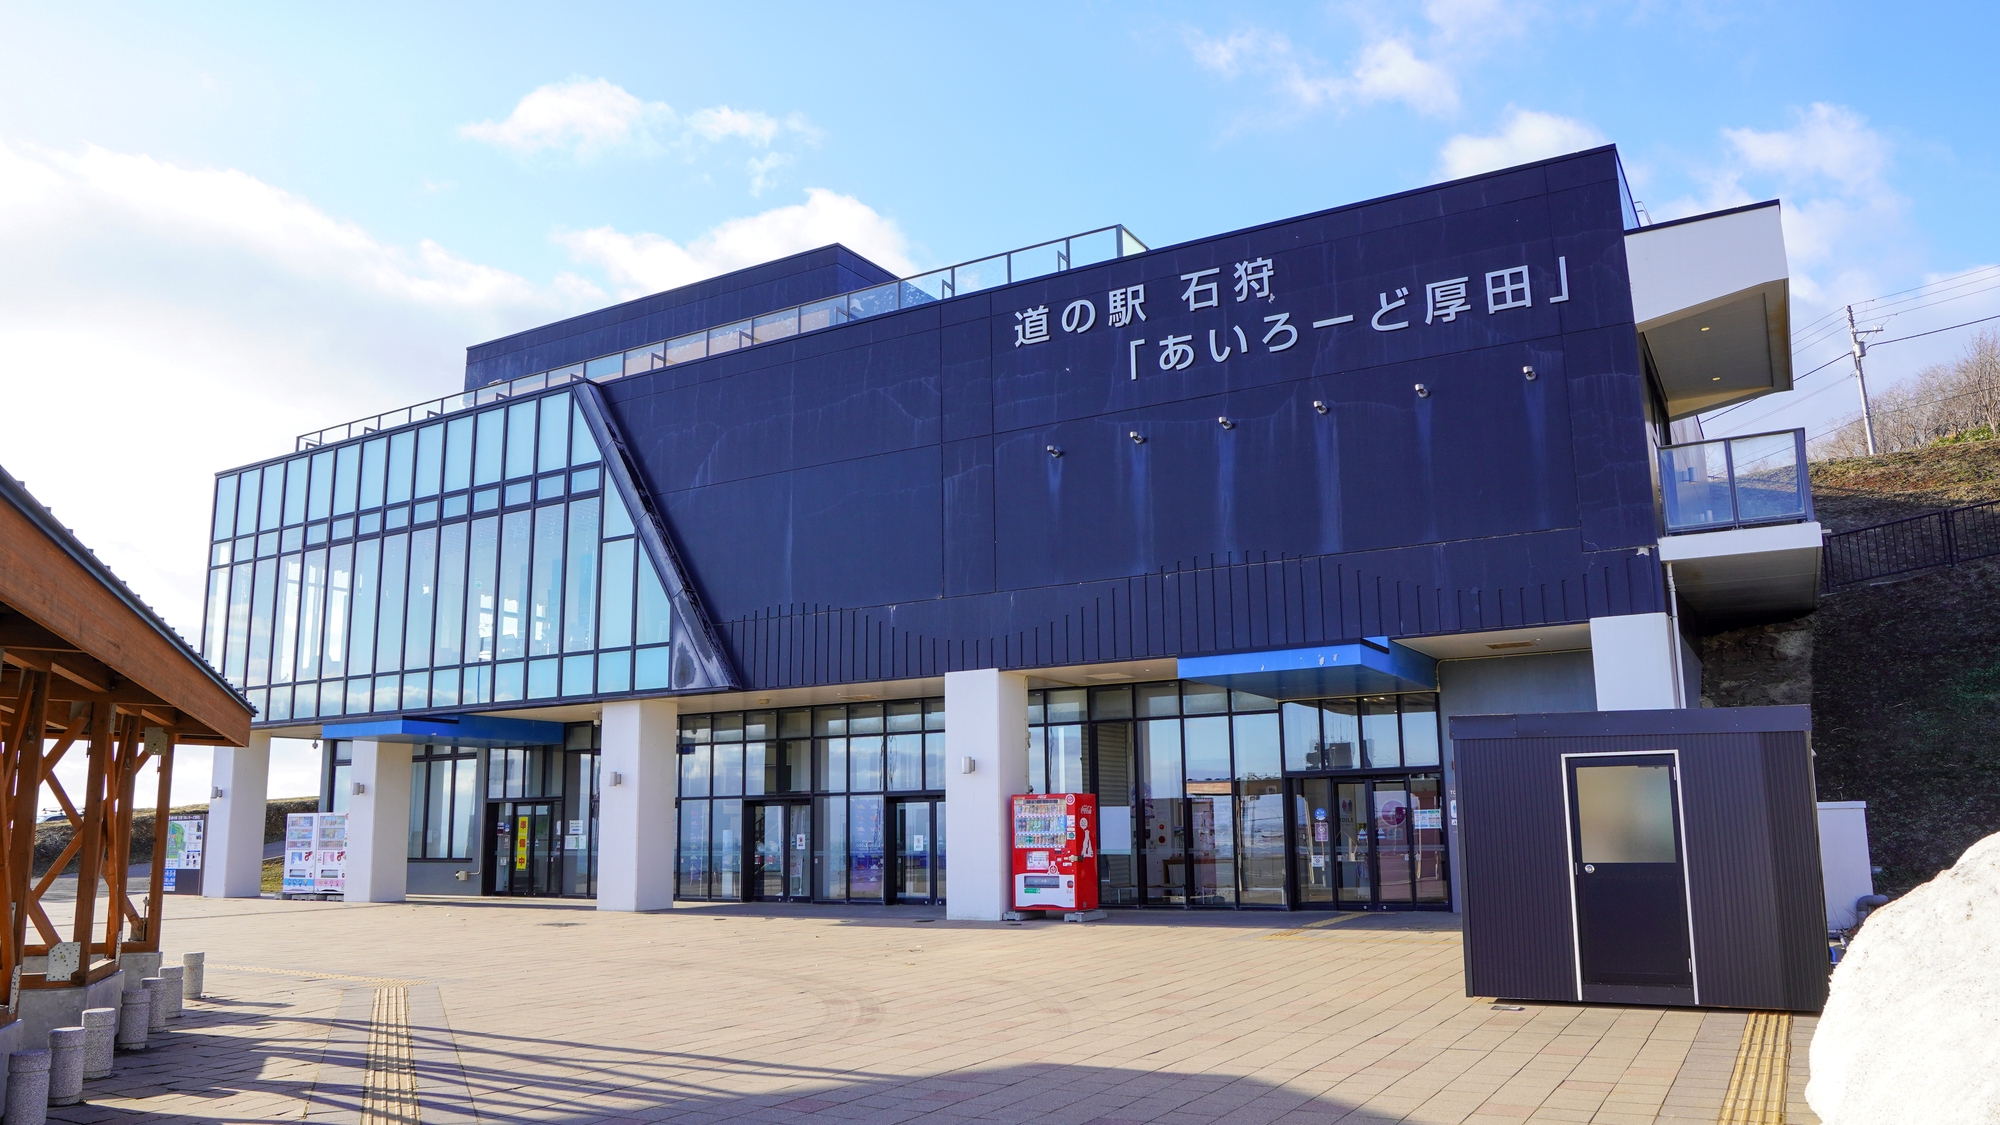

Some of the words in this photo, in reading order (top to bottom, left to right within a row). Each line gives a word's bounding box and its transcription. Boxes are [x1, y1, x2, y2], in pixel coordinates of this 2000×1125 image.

[1014, 284, 1147, 347] 道の駅
[1180, 257, 1275, 312] 石狩
[1130, 256, 1569, 380] 「あいろーど厚田」
